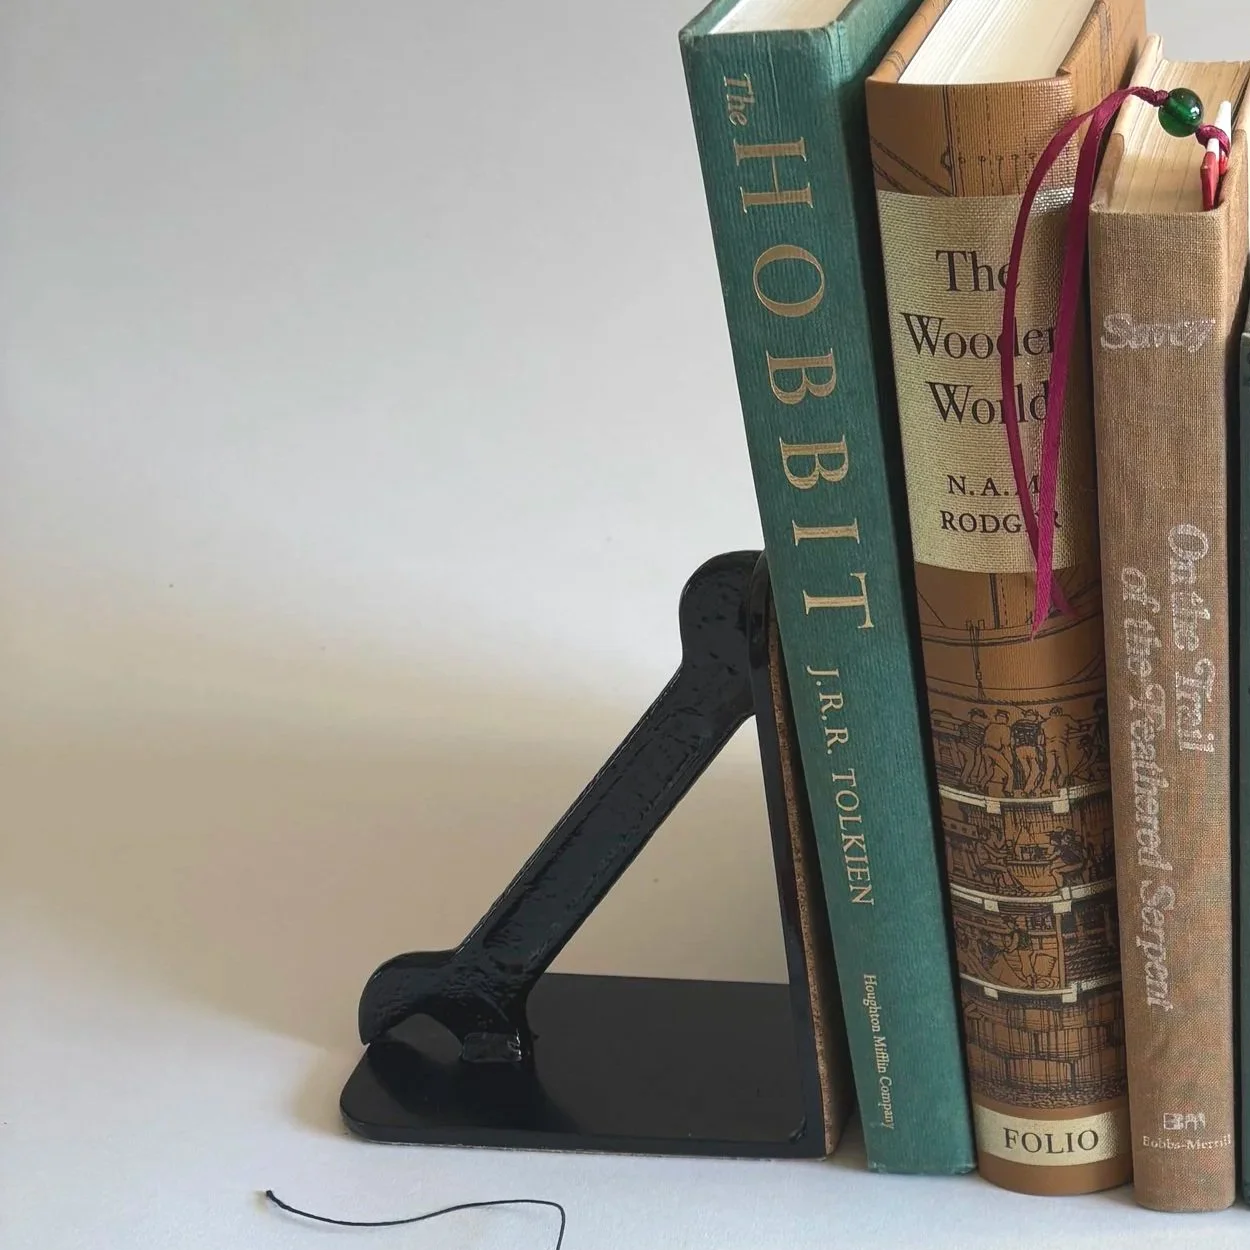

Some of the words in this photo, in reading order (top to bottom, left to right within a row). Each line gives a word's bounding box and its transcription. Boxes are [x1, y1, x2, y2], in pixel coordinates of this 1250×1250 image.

[723, 73, 755, 126] The
[734, 136, 875, 630] HOBBIT
[939, 510, 1062, 534] RODG
[1167, 524, 1210, 585] On
[1120, 566, 1161, 614] of
[1123, 616, 1163, 678] the
[1172, 591, 1211, 652] the
[1174, 657, 1216, 753] Trail
[1129, 683, 1173, 871] Feathered
[831, 767, 875, 906] TOLKIEN
[1135, 880, 1176, 1012] Serpent
[862, 973, 882, 1033] Houghton
[873, 1035, 890, 1074] Mifflin
[877, 1075, 895, 1130] Company
[1003, 1126, 1100, 1155] FOLIO
